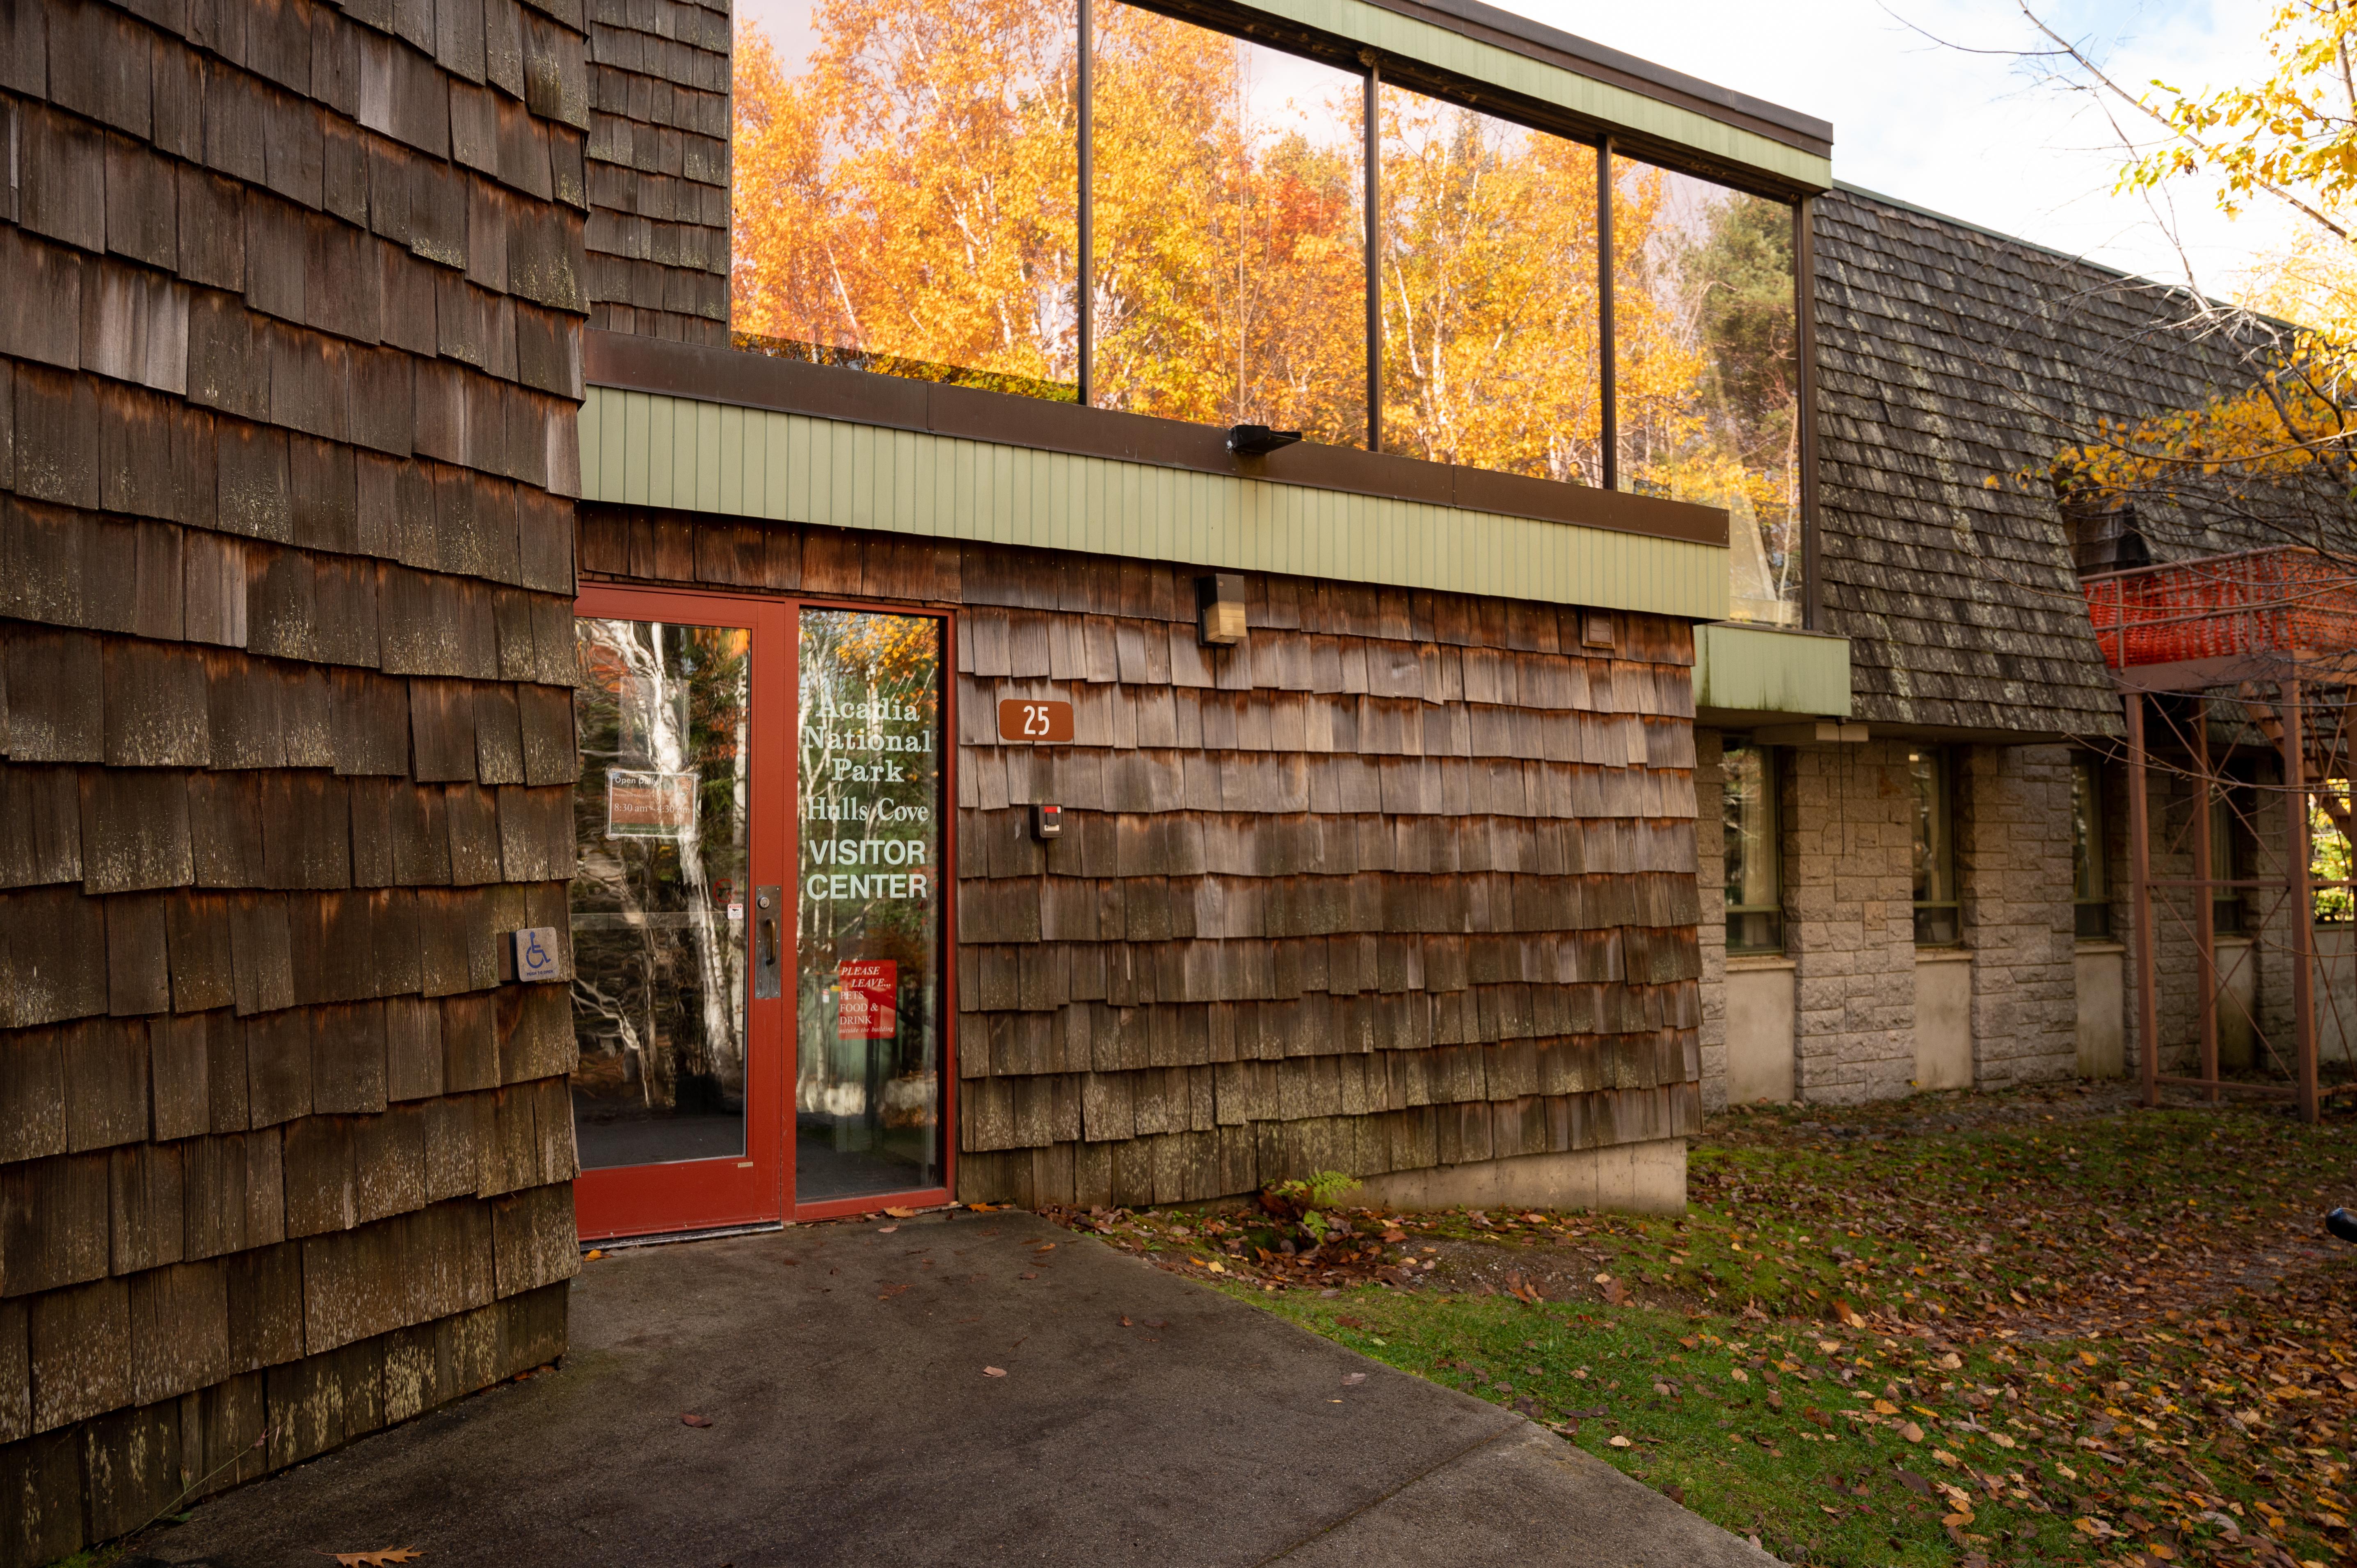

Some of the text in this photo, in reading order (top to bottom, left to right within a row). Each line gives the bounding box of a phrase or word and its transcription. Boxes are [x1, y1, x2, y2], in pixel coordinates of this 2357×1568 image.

[816, 695, 920, 722] Acadia
[1023, 705, 1050, 736] 25
[802, 725, 932, 752] National
[832, 758, 905, 782] Park
[615, 777, 658, 786] Open Daily
[614, 803, 633, 811] 8:30
[656, 805, 675, 813] 4:30
[807, 796, 929, 821] Hulls Cove
[809, 839, 926, 866] VISITOR
[807, 874, 927, 900] CENTER
[841, 966, 880, 976] PLEASE
[852, 978, 891, 987] LEAVE...
[840, 990, 864, 1000] PETS
[840, 1002, 878, 1013] FOOD &
[840, 1015, 872, 1025] DRINK
